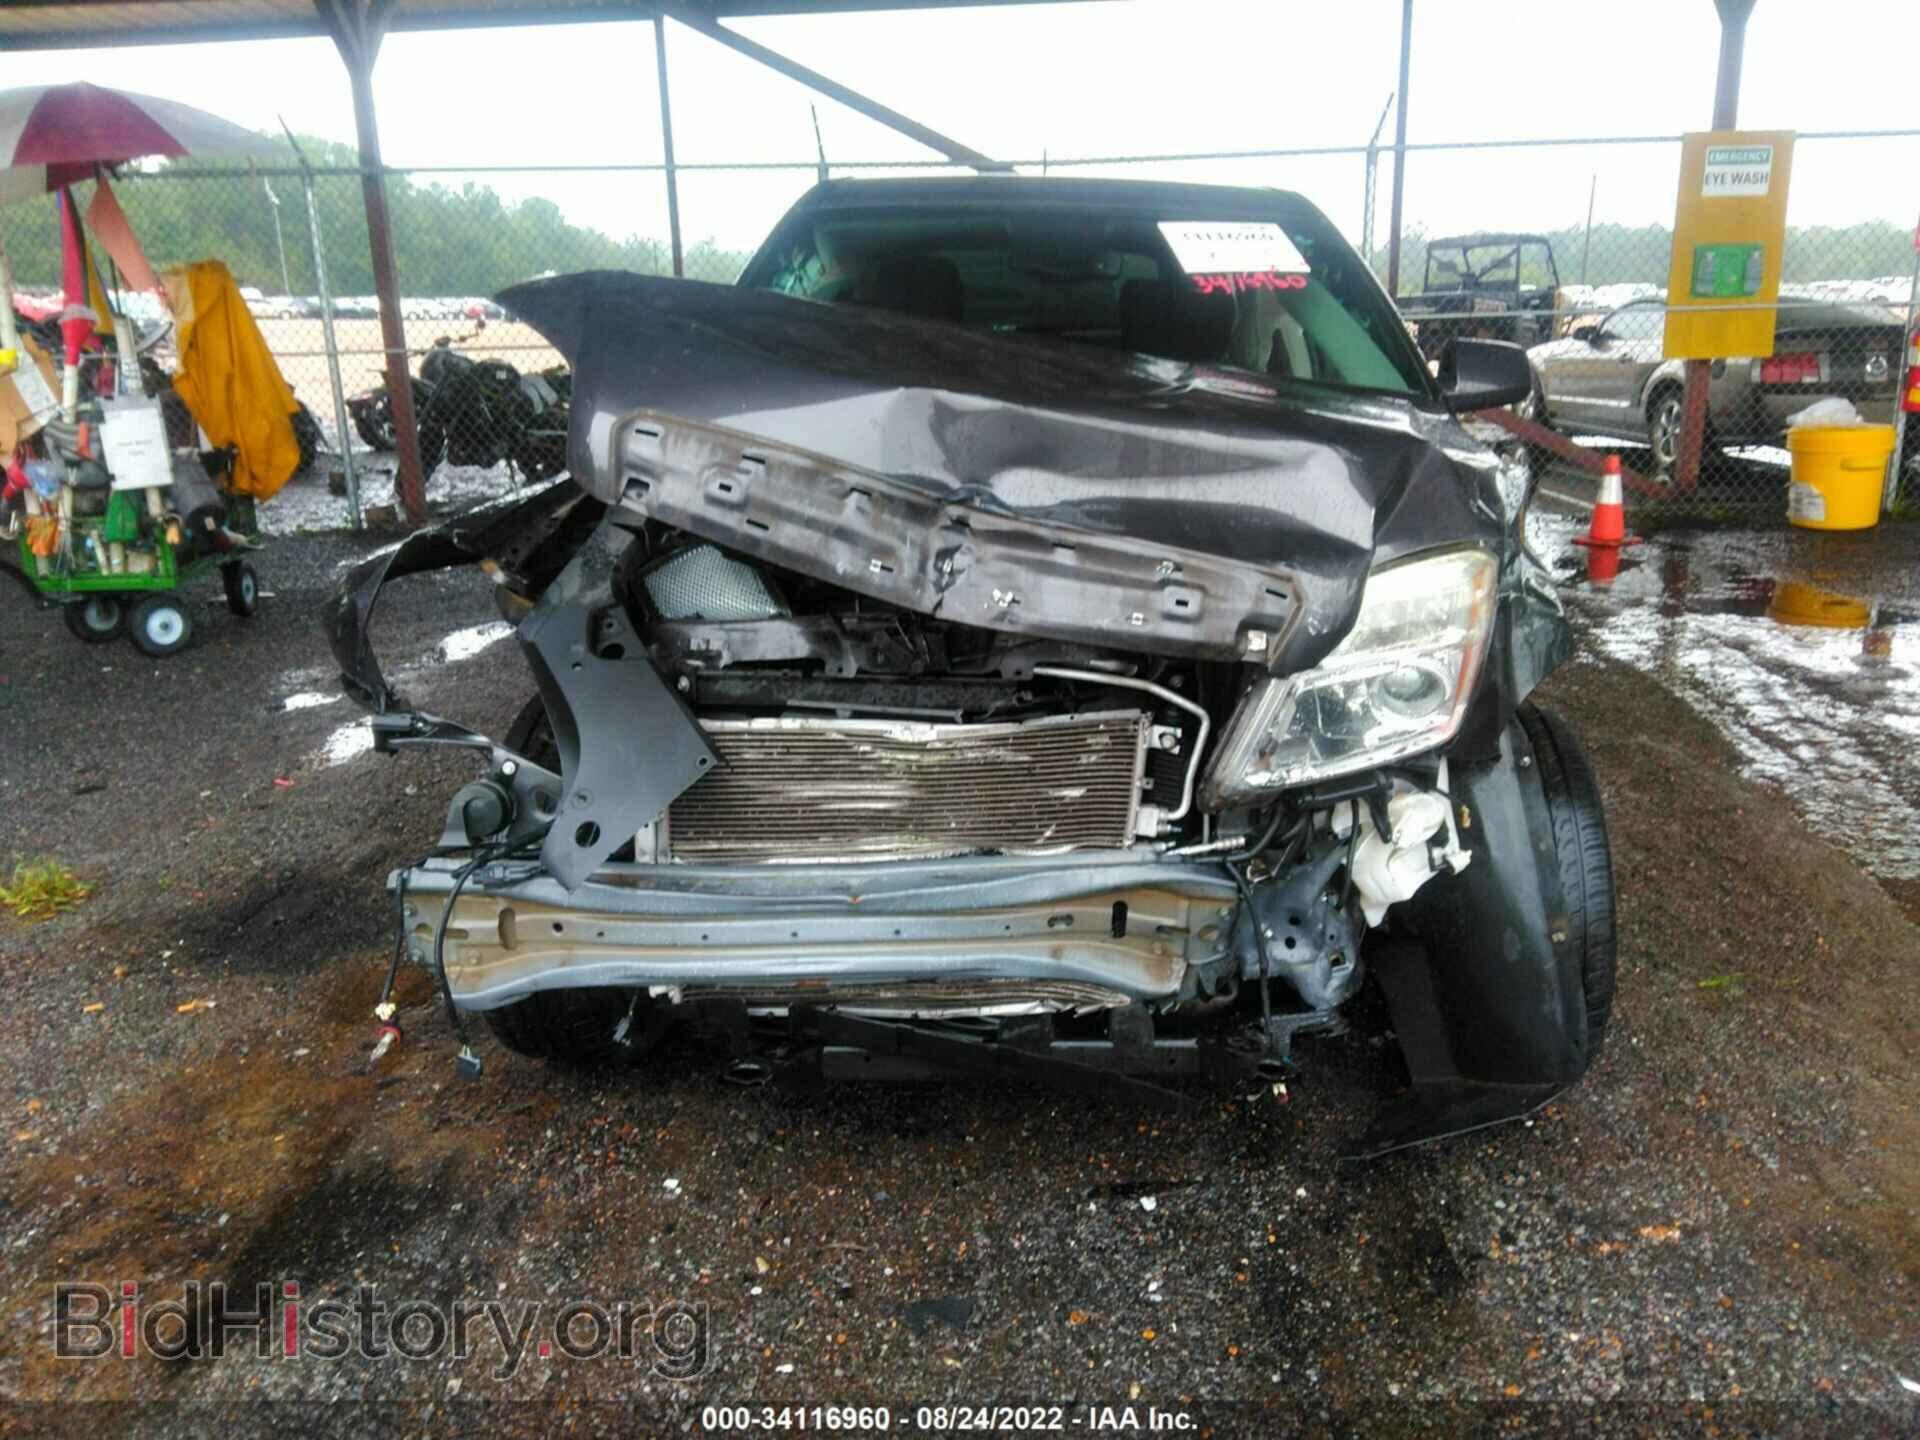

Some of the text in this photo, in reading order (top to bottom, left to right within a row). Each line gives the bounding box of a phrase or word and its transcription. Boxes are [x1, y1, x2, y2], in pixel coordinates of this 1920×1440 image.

[1709, 151, 1767, 162] EMERGENCY
[1705, 171, 1768, 186] EYE WASH
